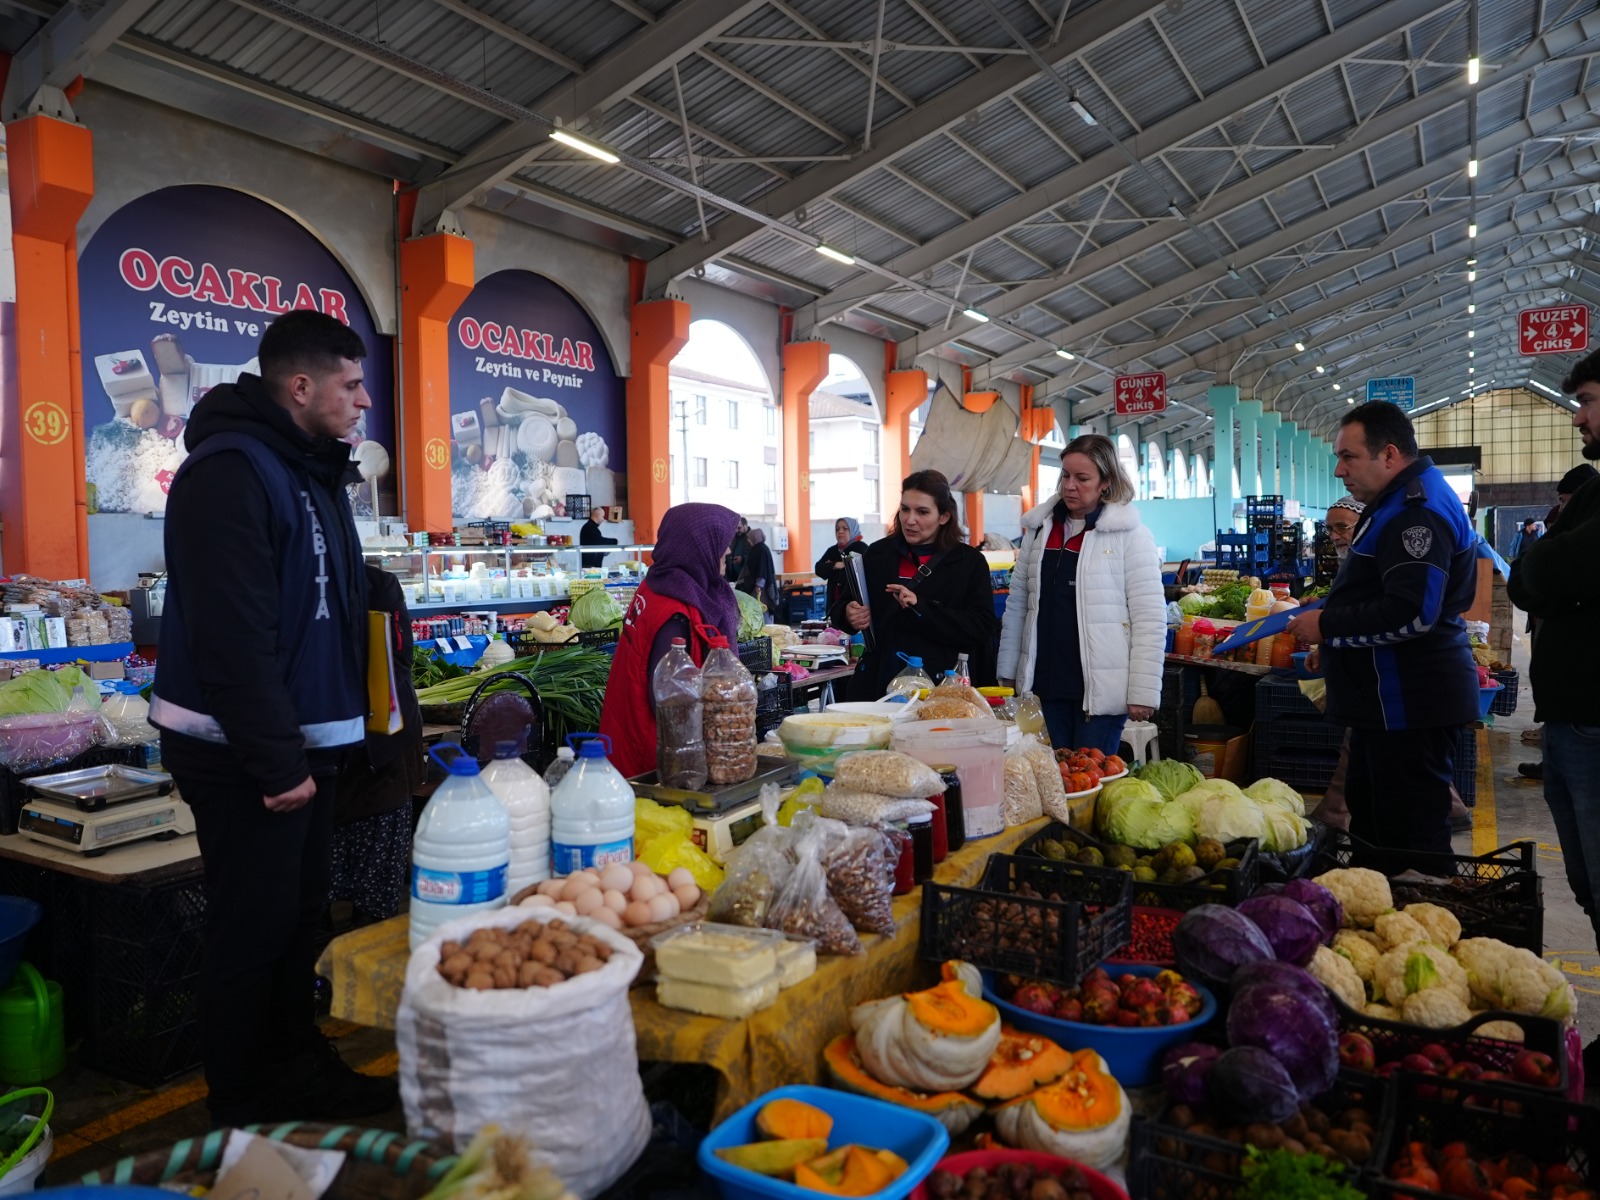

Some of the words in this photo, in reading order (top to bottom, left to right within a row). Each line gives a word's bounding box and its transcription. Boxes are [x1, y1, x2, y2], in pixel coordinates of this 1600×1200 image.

[119, 248, 350, 327] OCAKLAR
[149, 301, 229, 333] Zeytin
[234, 320, 259, 337] ve
[1529, 308, 1580, 324] KUZEY
[1546, 323, 1558, 338] 4
[458, 317, 595, 372] OCAKLAR
[1533, 338, 1572, 352] ÇIKIŞ
[475, 356, 522, 378] Zeytin
[524, 367, 540, 382] ve
[542, 368, 583, 388] Peynir
[1120, 376, 1159, 389] GÜNEY
[1135, 387, 1143, 400] 4
[1126, 401, 1155, 412] ÇIKIŞ
[33, 410, 61, 437] 39
[429, 444, 445, 464] 38
[301, 490, 330, 620] ZABITA
